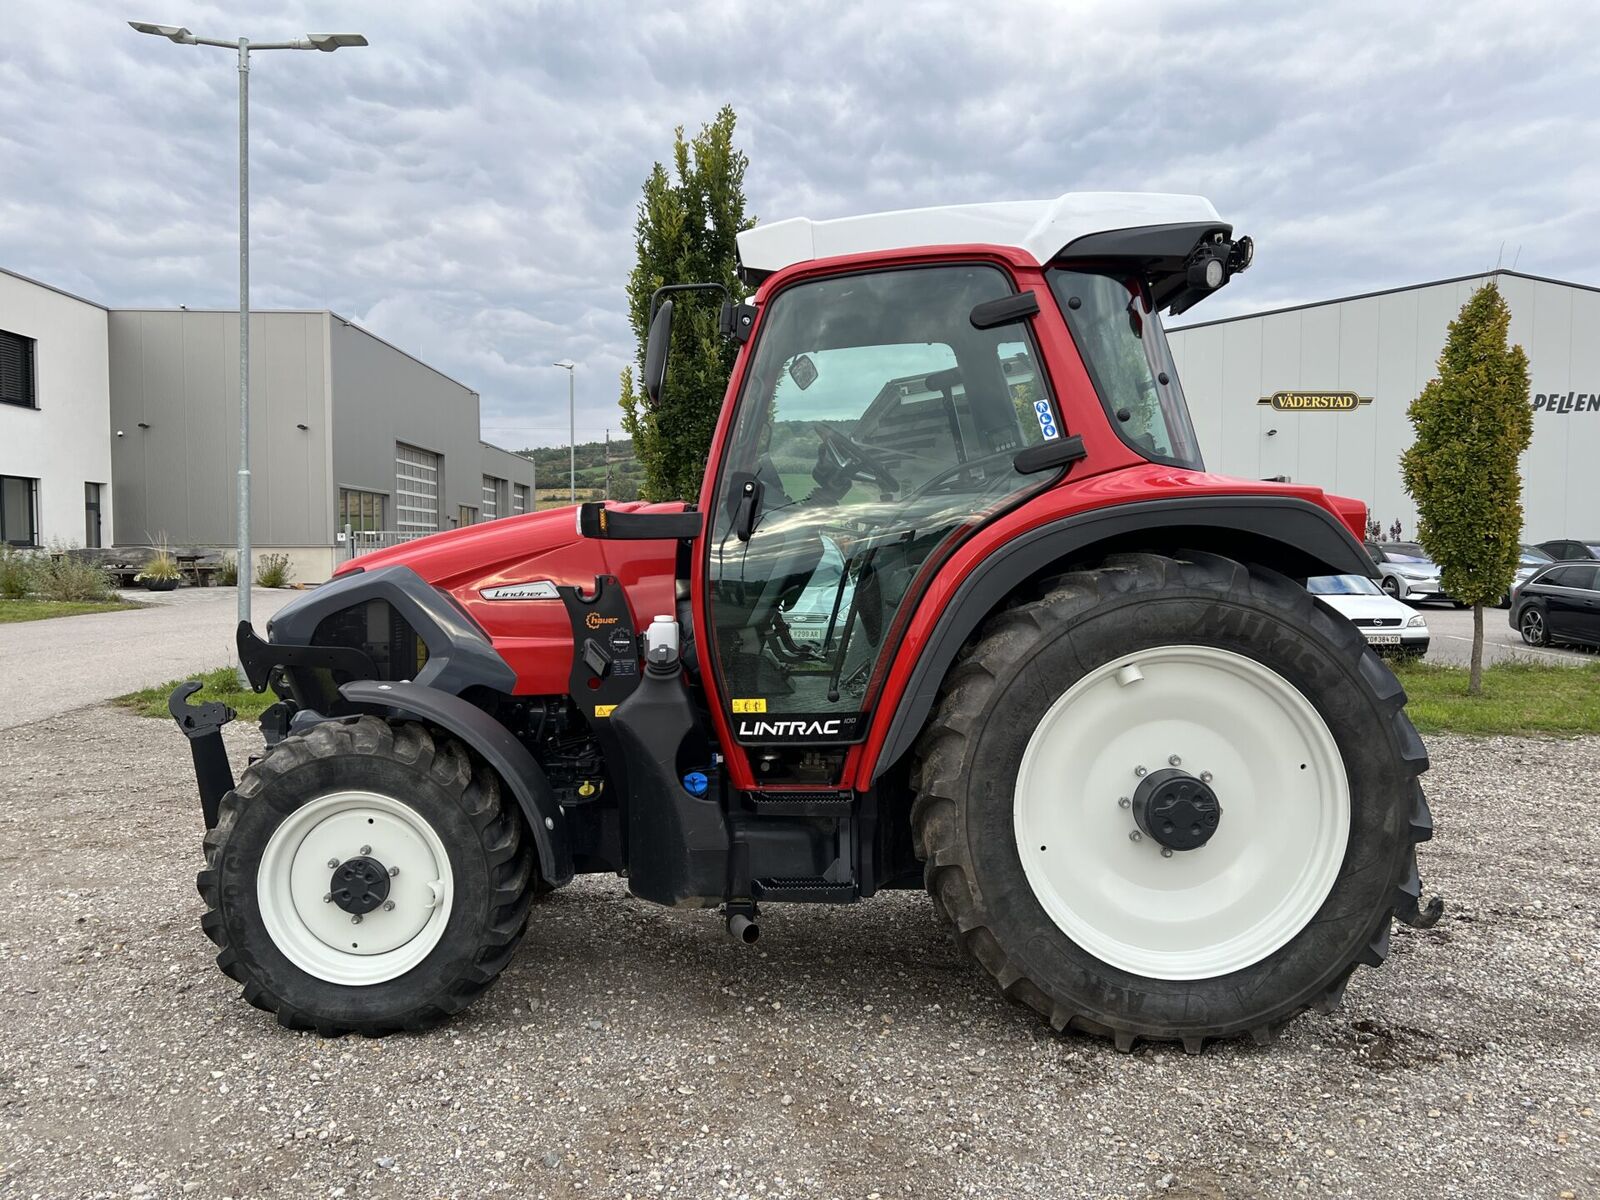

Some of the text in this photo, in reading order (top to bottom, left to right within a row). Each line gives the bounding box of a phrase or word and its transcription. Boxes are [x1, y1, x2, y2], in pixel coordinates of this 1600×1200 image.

[1278, 393, 1354, 408] VÄDERSTAD
[1533, 391, 1600, 414] PELLEN
[494, 590, 548, 598] Lindner
[590, 615, 619, 625] hauer
[739, 719, 841, 736] LINTRAC
